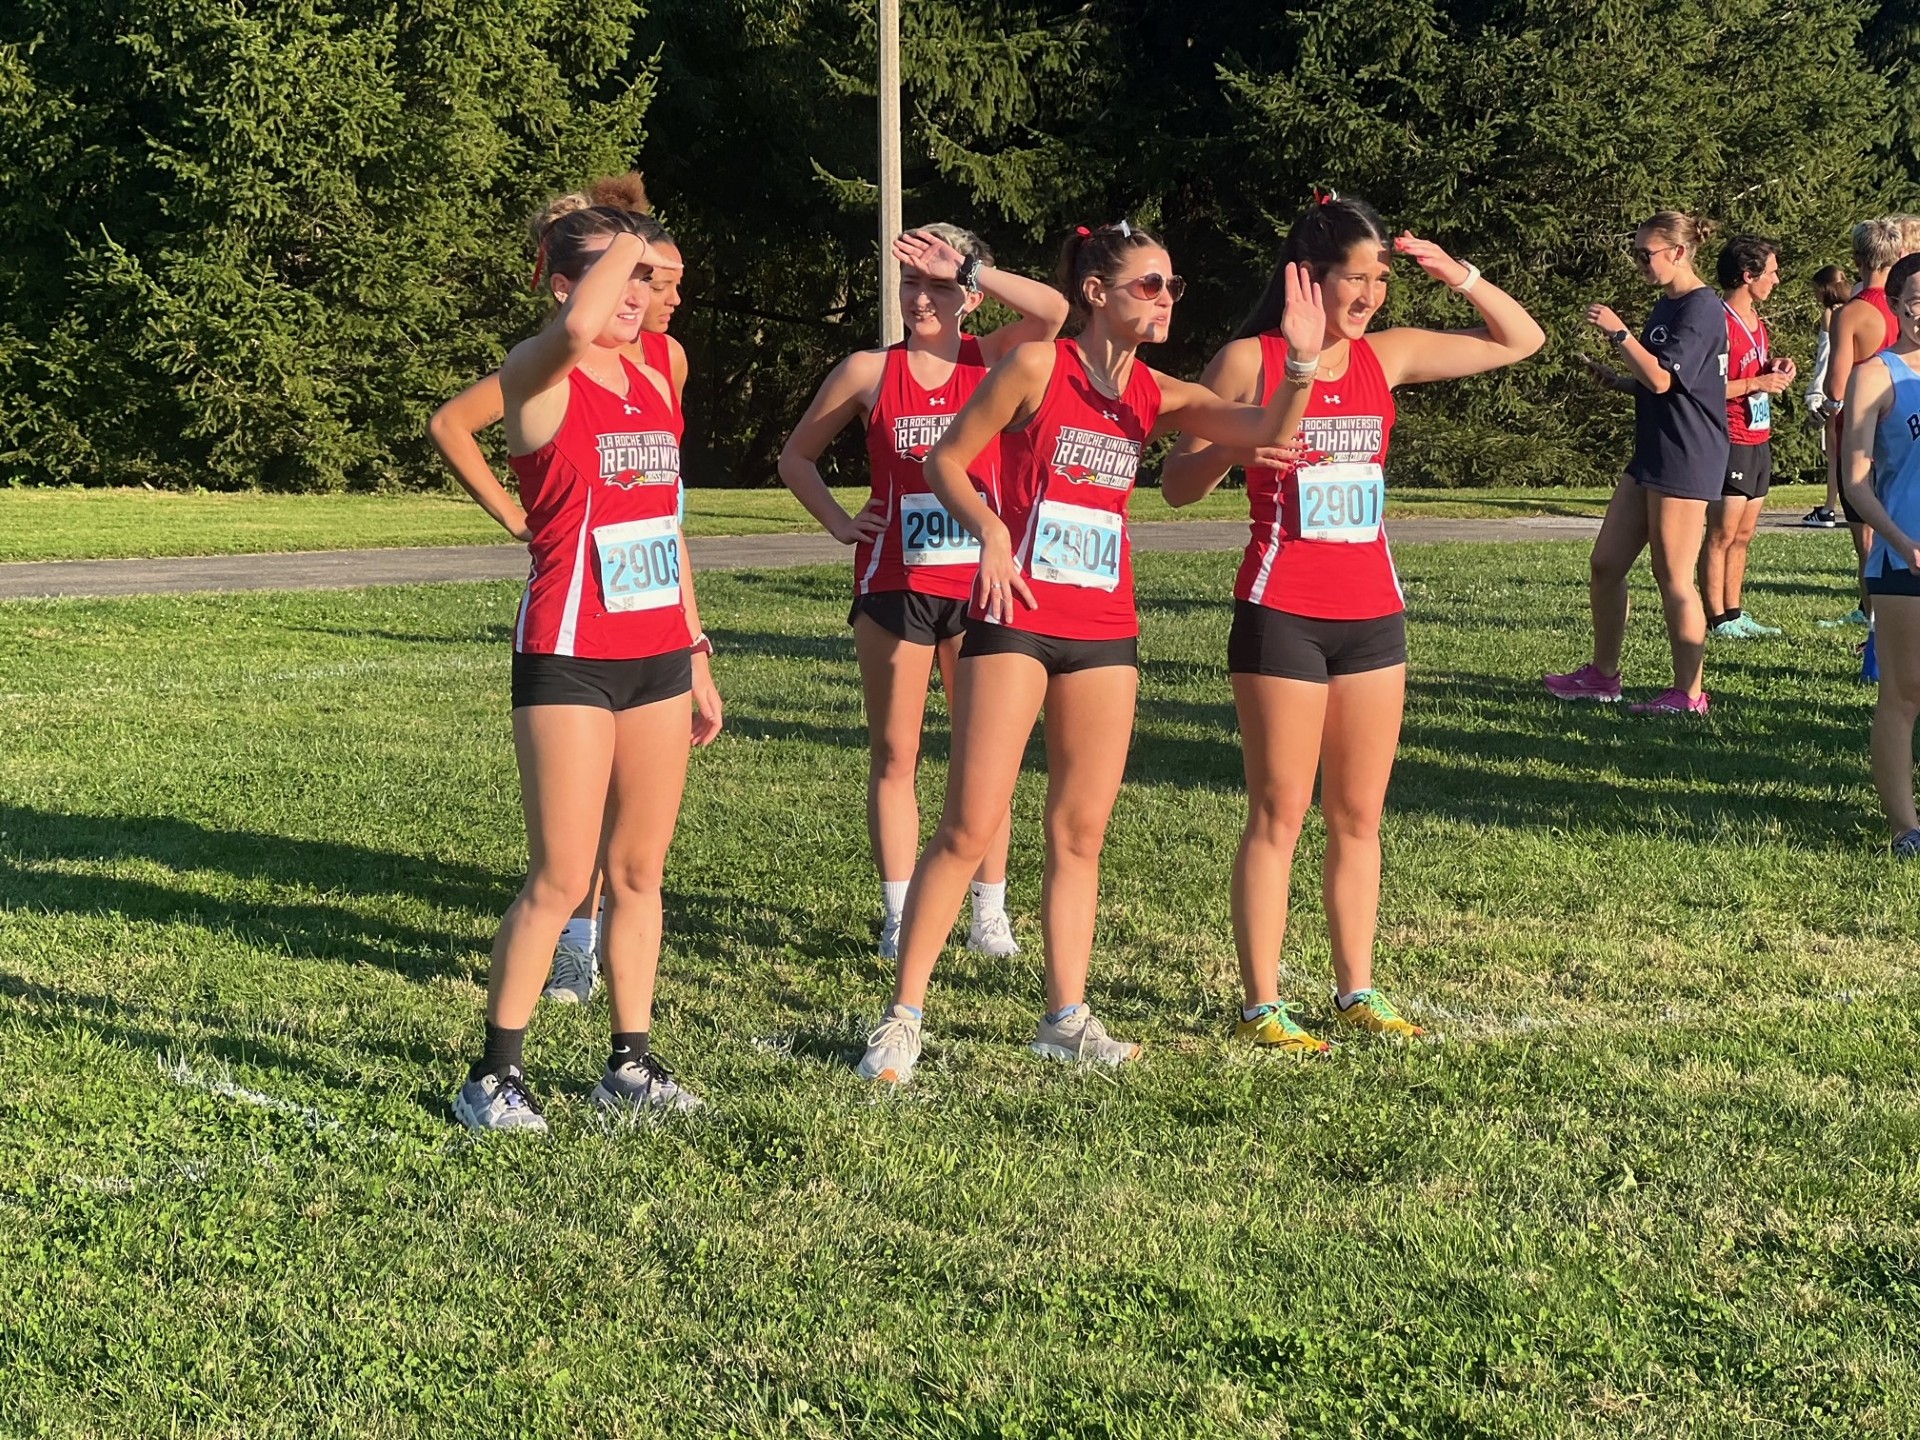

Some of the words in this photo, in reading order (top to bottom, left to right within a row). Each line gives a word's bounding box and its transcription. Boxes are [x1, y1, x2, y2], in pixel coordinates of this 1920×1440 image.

[898, 418, 909, 429] LA
[909, 417, 936, 428] ROCHE
[1305, 419, 1332, 430] ROCHE
[1335, 418, 1380, 430] UNIVERSITY
[601, 437, 614, 448] LA
[614, 434, 643, 447] ROCHE
[898, 426, 947, 448] REDH
[1062, 429, 1074, 442] LA
[1075, 432, 1105, 448] ROCHE
[1293, 430, 1380, 452] EDHAWKS
[603, 446, 679, 473] REDHAWKS
[1306, 483, 1378, 527] 2901
[1039, 521, 1117, 575] 2904
[607, 538, 679, 592] 2903
